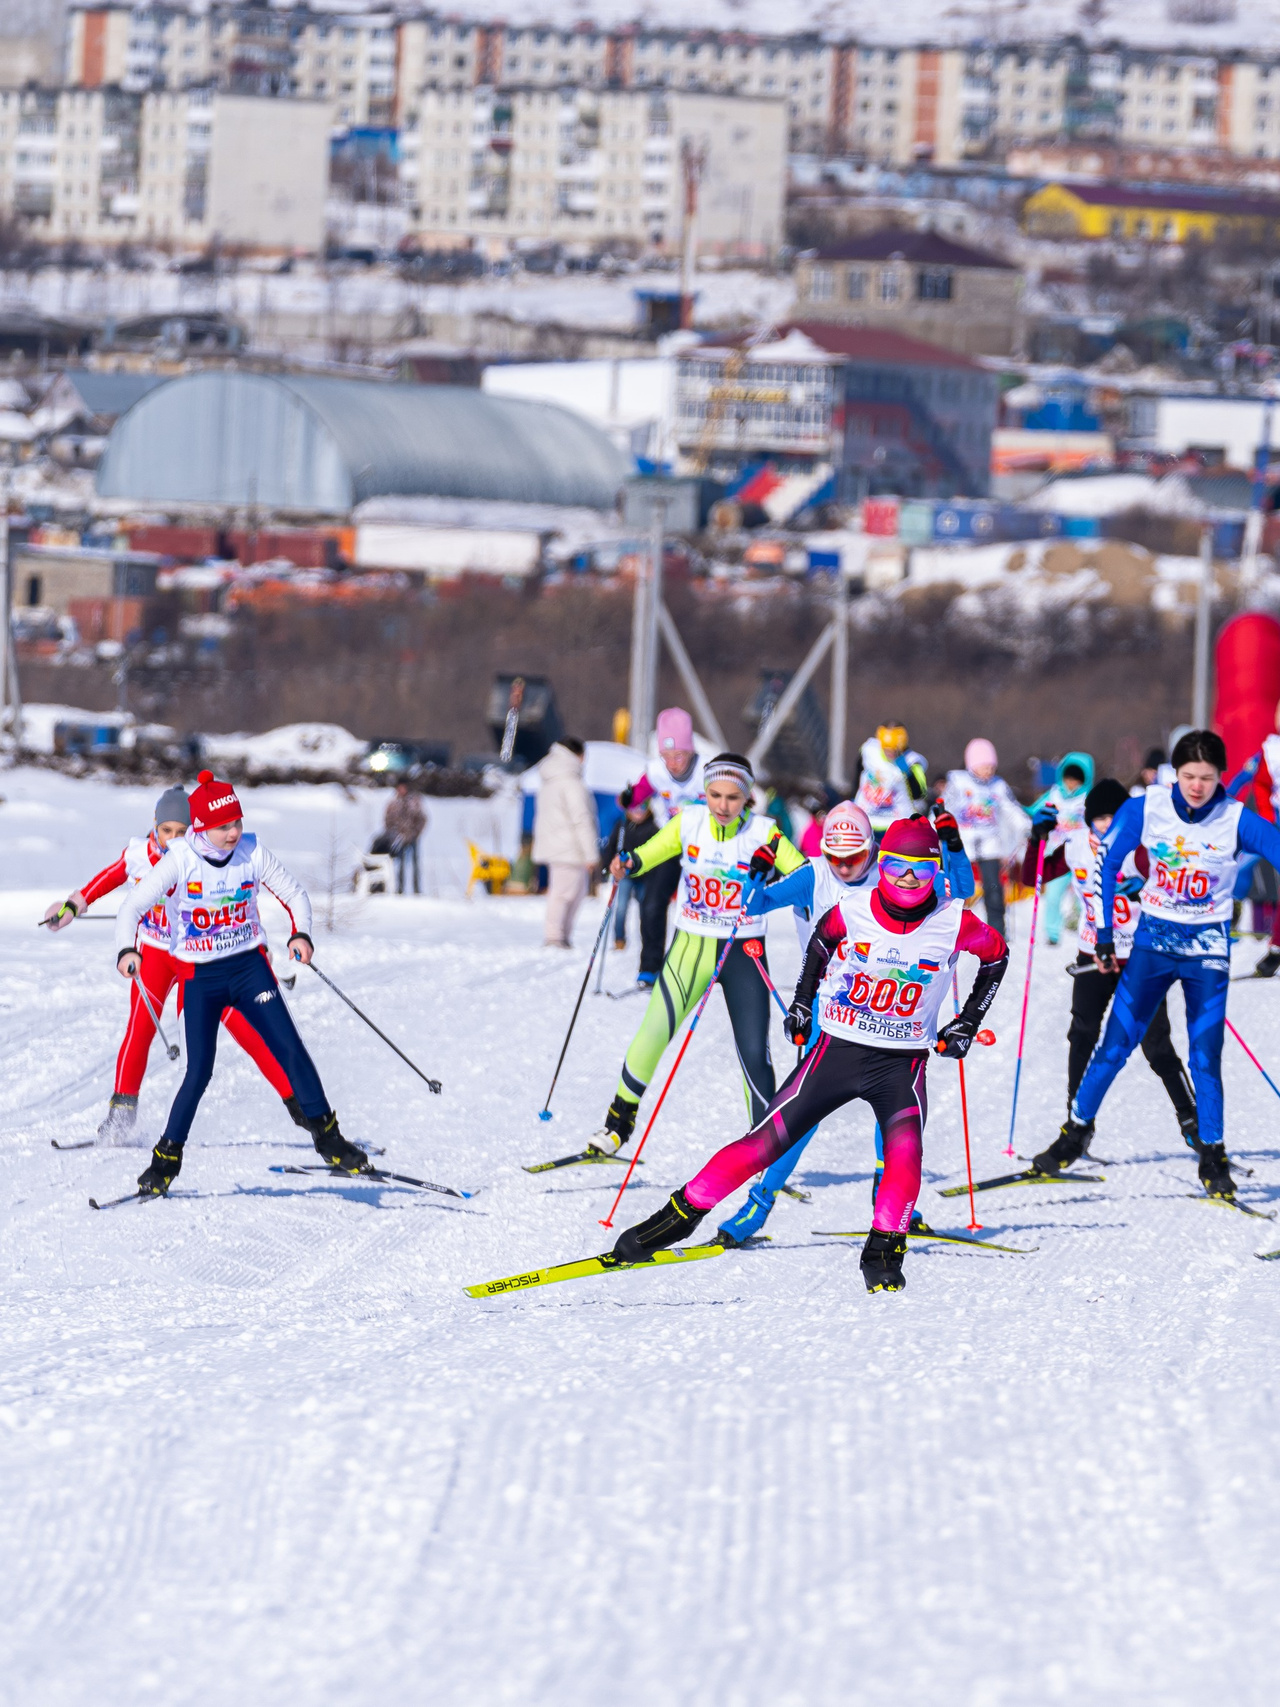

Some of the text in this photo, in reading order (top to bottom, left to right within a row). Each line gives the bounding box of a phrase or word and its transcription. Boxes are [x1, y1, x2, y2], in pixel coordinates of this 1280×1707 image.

[688, 873, 742, 910] 382
[848, 972, 924, 1017] 609
[485, 1272, 541, 1295] FISCHER
